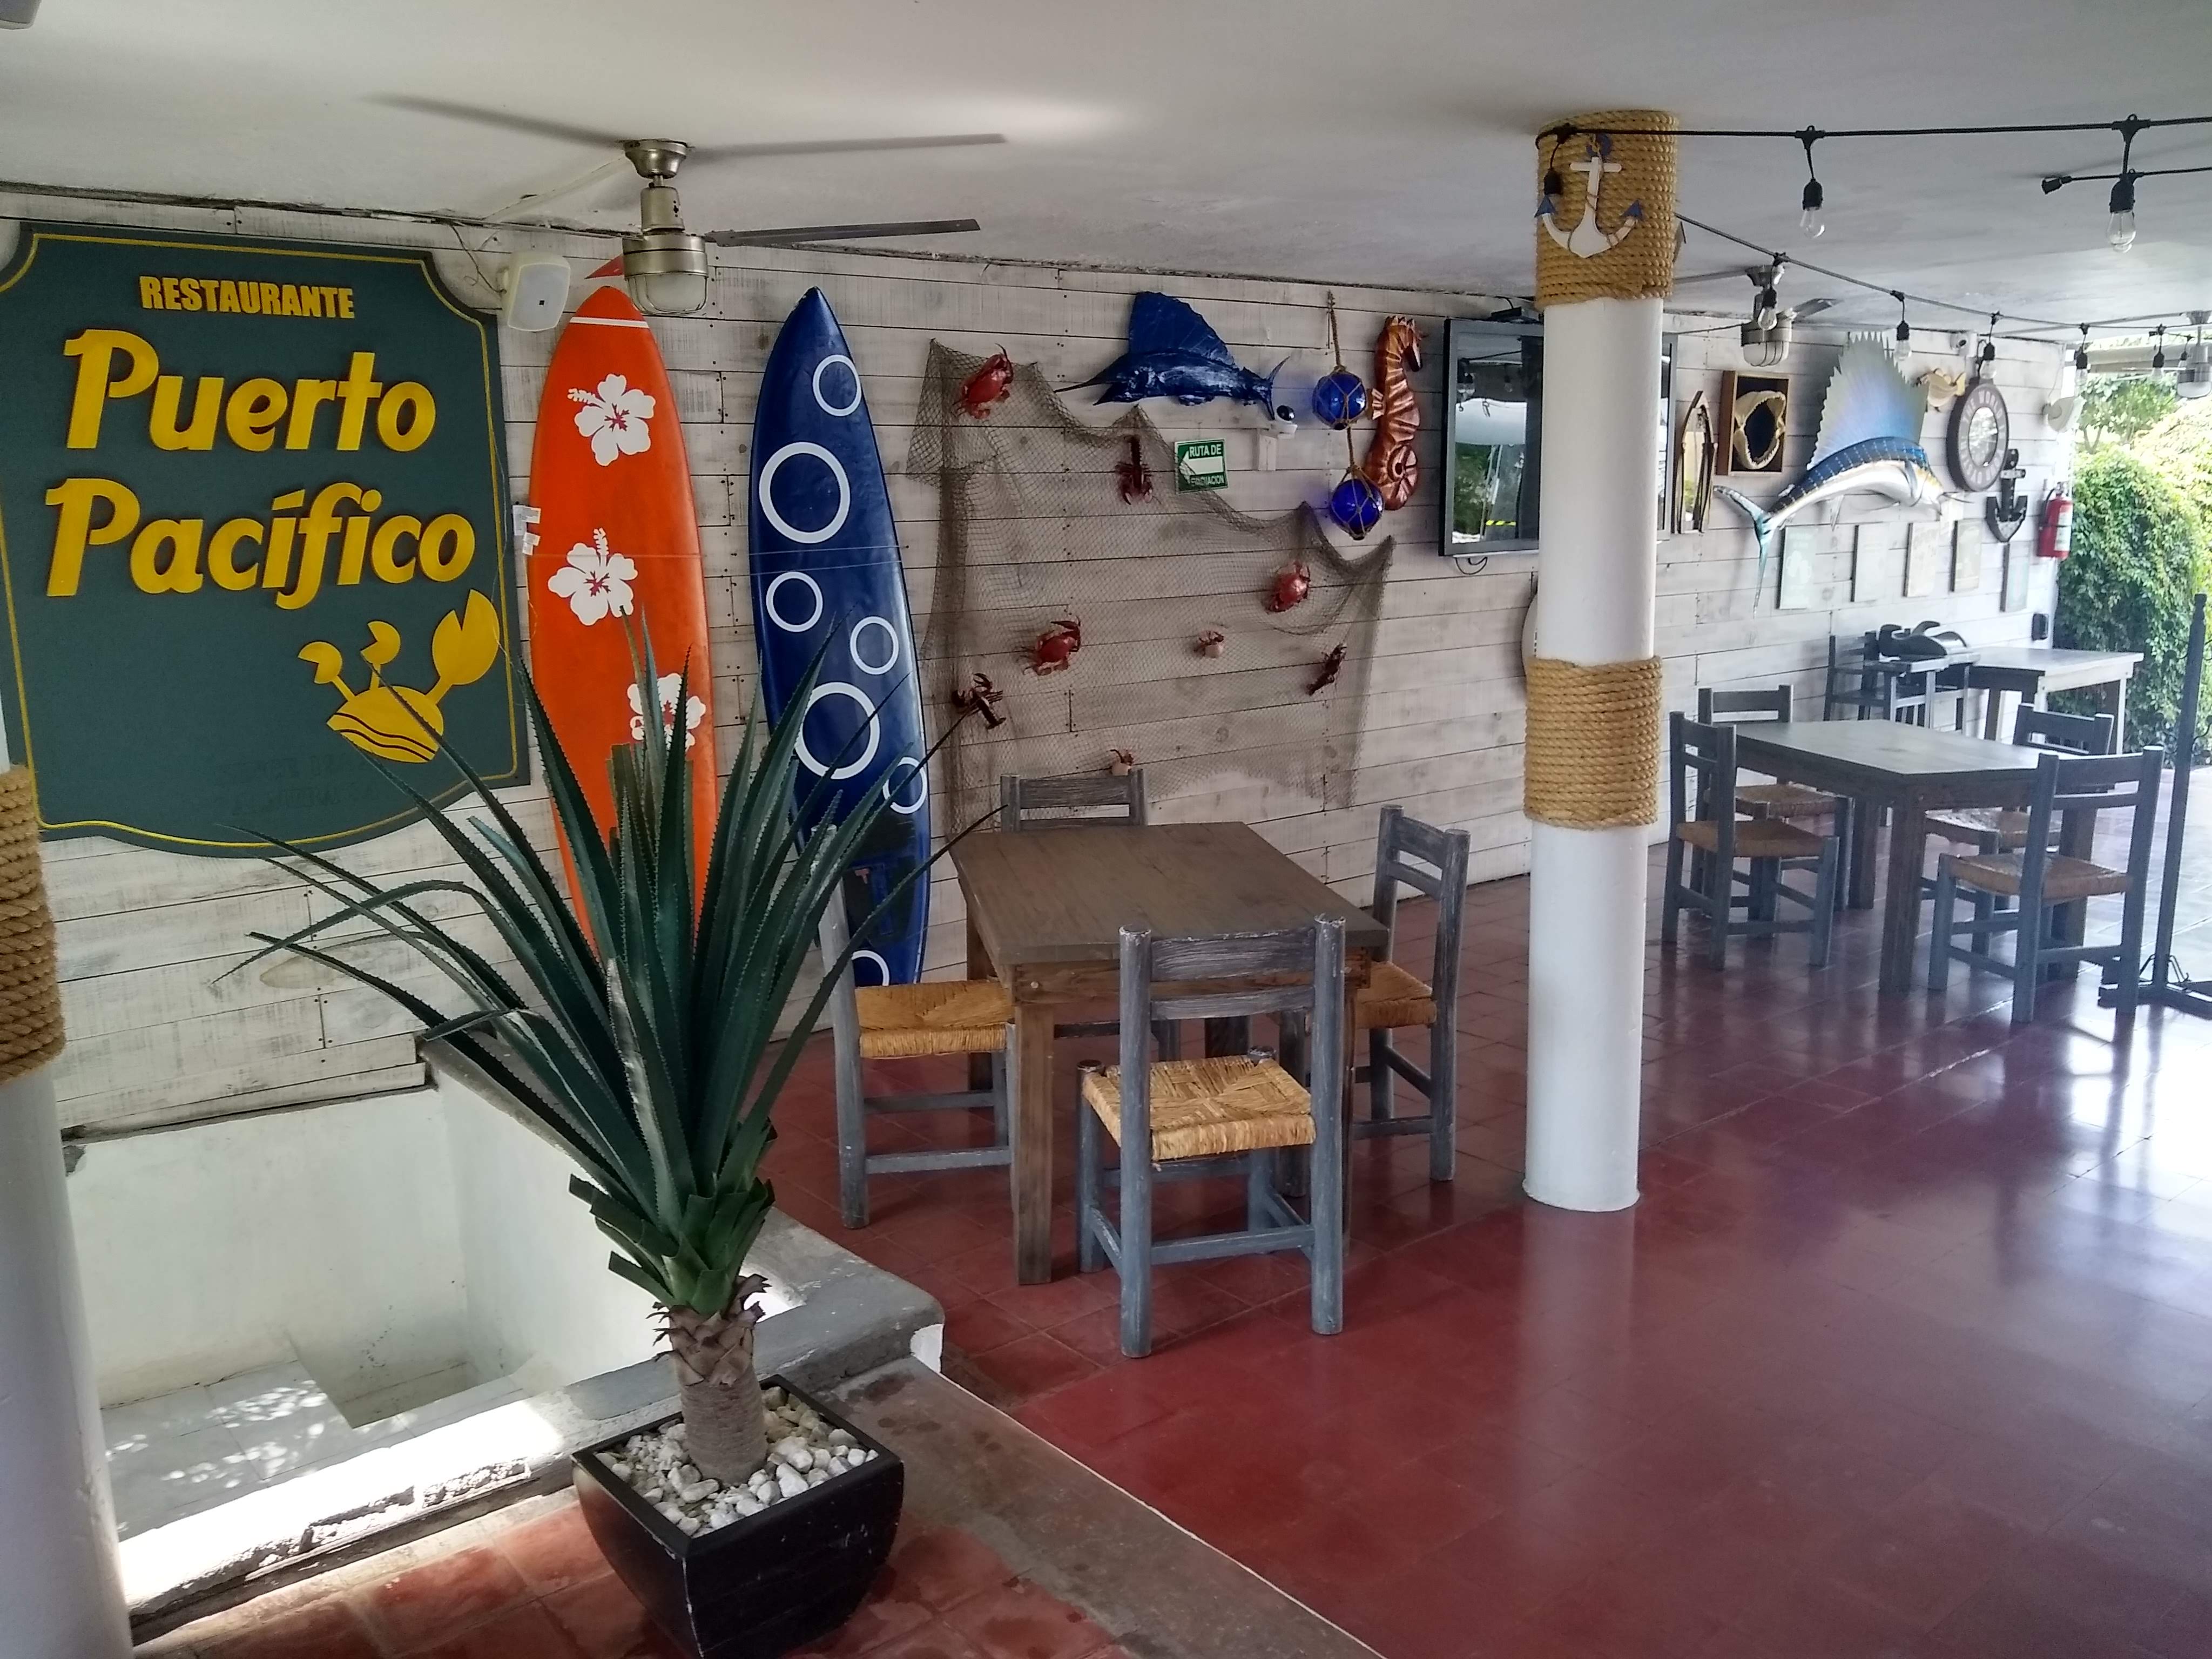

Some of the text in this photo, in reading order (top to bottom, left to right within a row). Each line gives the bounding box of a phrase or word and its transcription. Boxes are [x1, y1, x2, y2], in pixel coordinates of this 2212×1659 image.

[139, 275, 355, 319] RESTAURANTE
[63, 328, 436, 452] Puerto
[1978, 390, 2003, 419] WORLD
[1189, 443, 1222, 457] RUTA DE
[45, 477, 476, 610] Pacífico
